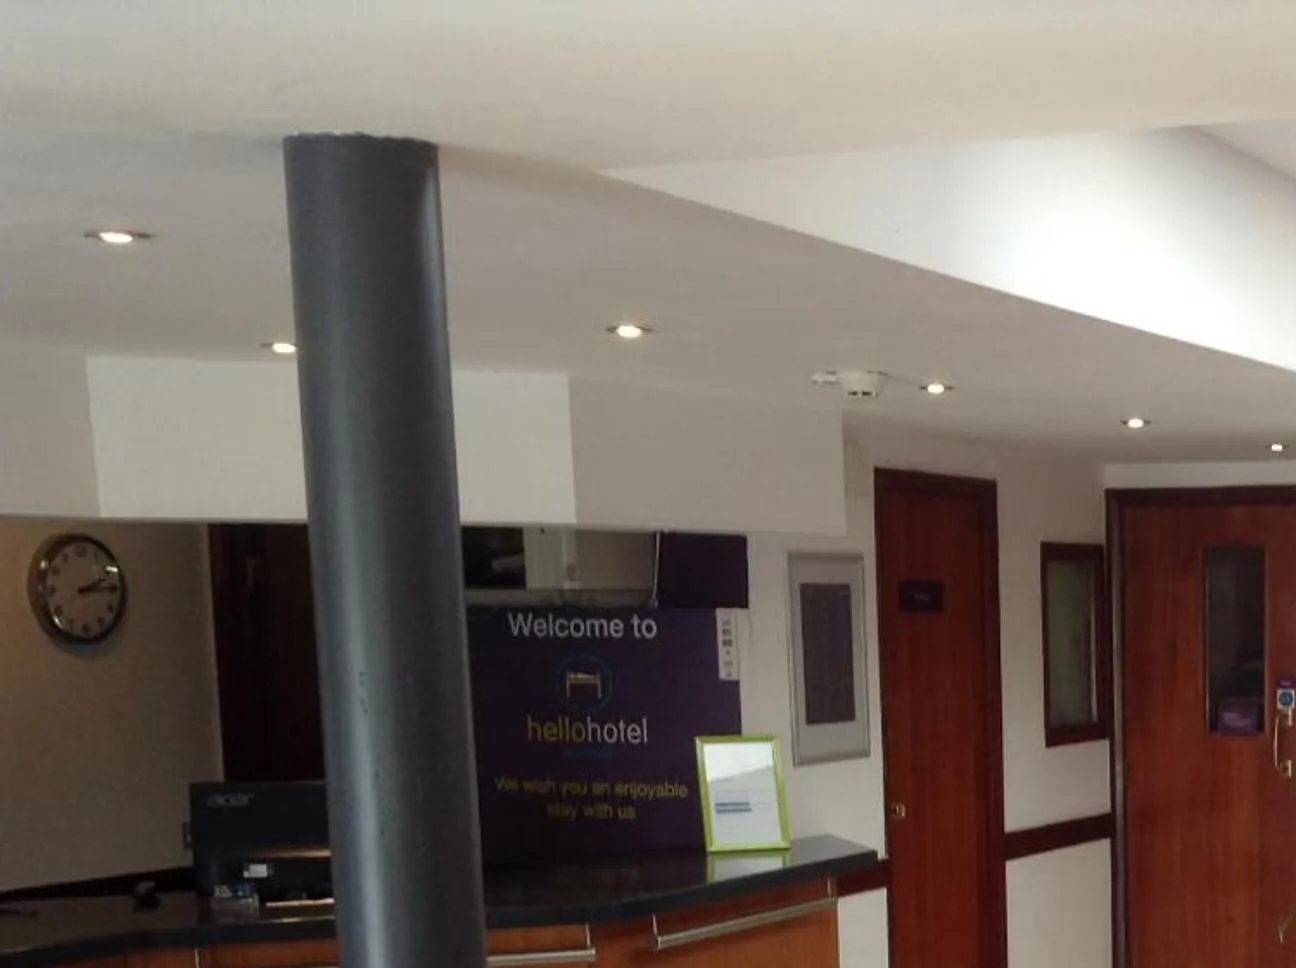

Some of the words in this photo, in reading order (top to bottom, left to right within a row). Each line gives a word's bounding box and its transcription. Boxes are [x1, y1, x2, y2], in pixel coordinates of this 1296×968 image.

[508, 611, 624, 639] Welcome
[631, 613, 658, 639] to
[527, 716, 648, 745] hellohotel
[495, 776, 518, 792] We
[561, 781, 588, 798] you
[592, 782, 610, 796] an
[614, 779, 689, 800] enjoyable
[547, 803, 578, 821] stay
[582, 803, 613, 819] with
[617, 805, 636, 820] us
